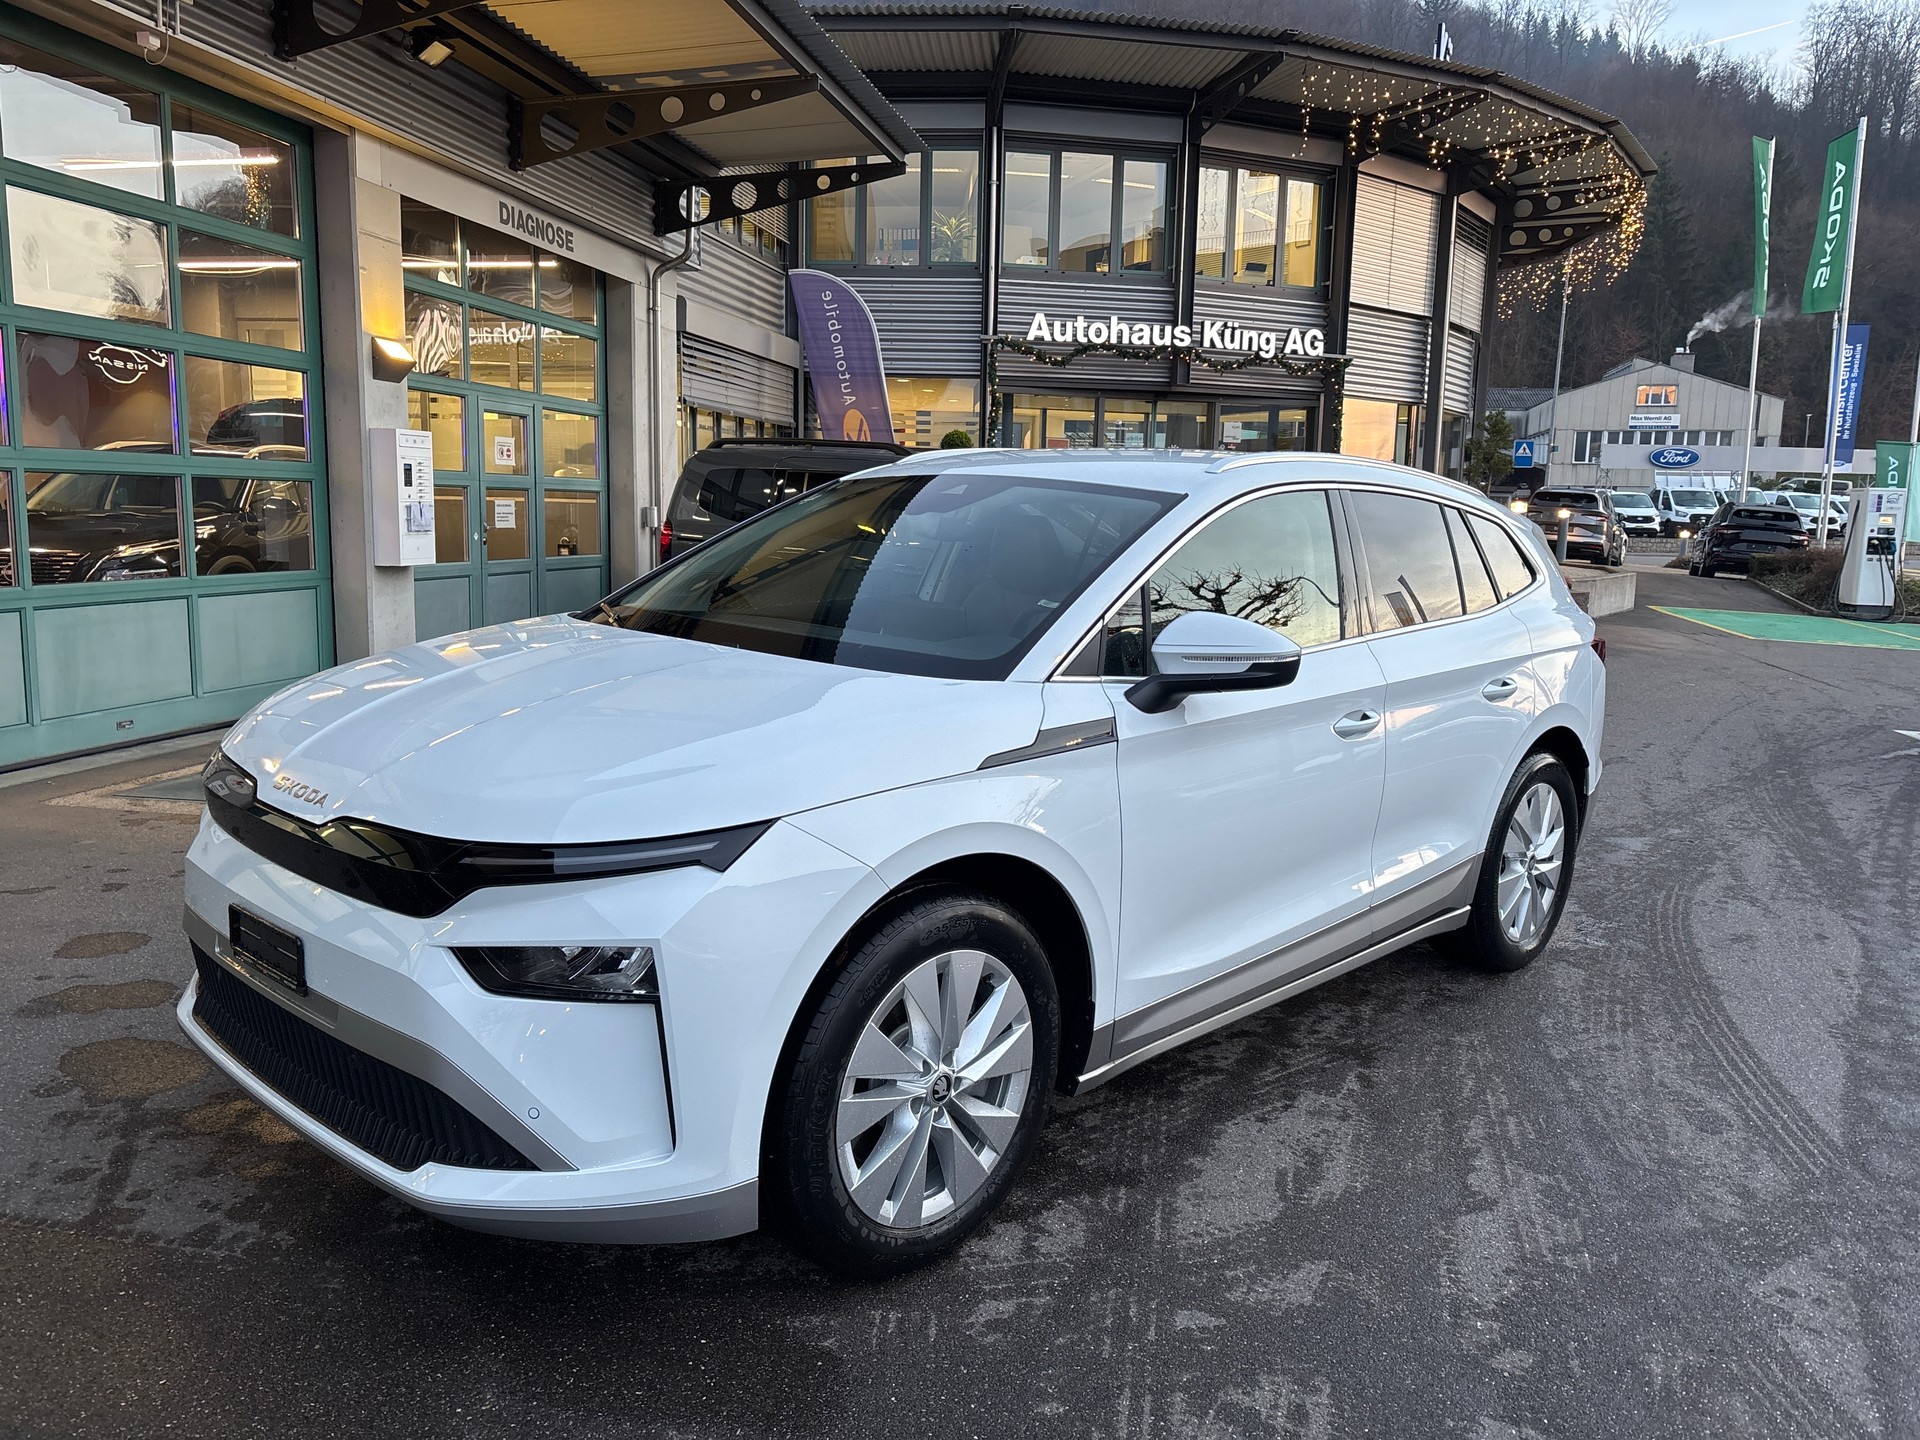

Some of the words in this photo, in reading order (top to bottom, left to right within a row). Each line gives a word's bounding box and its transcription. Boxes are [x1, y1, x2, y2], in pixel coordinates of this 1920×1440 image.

[498, 200, 575, 253] DIAGNOSE
[1026, 312, 1192, 347] Autohaus
[1202, 320, 1277, 359] Küng
[1283, 328, 1325, 357] AG
[1660, 449, 1692, 463] Ford
